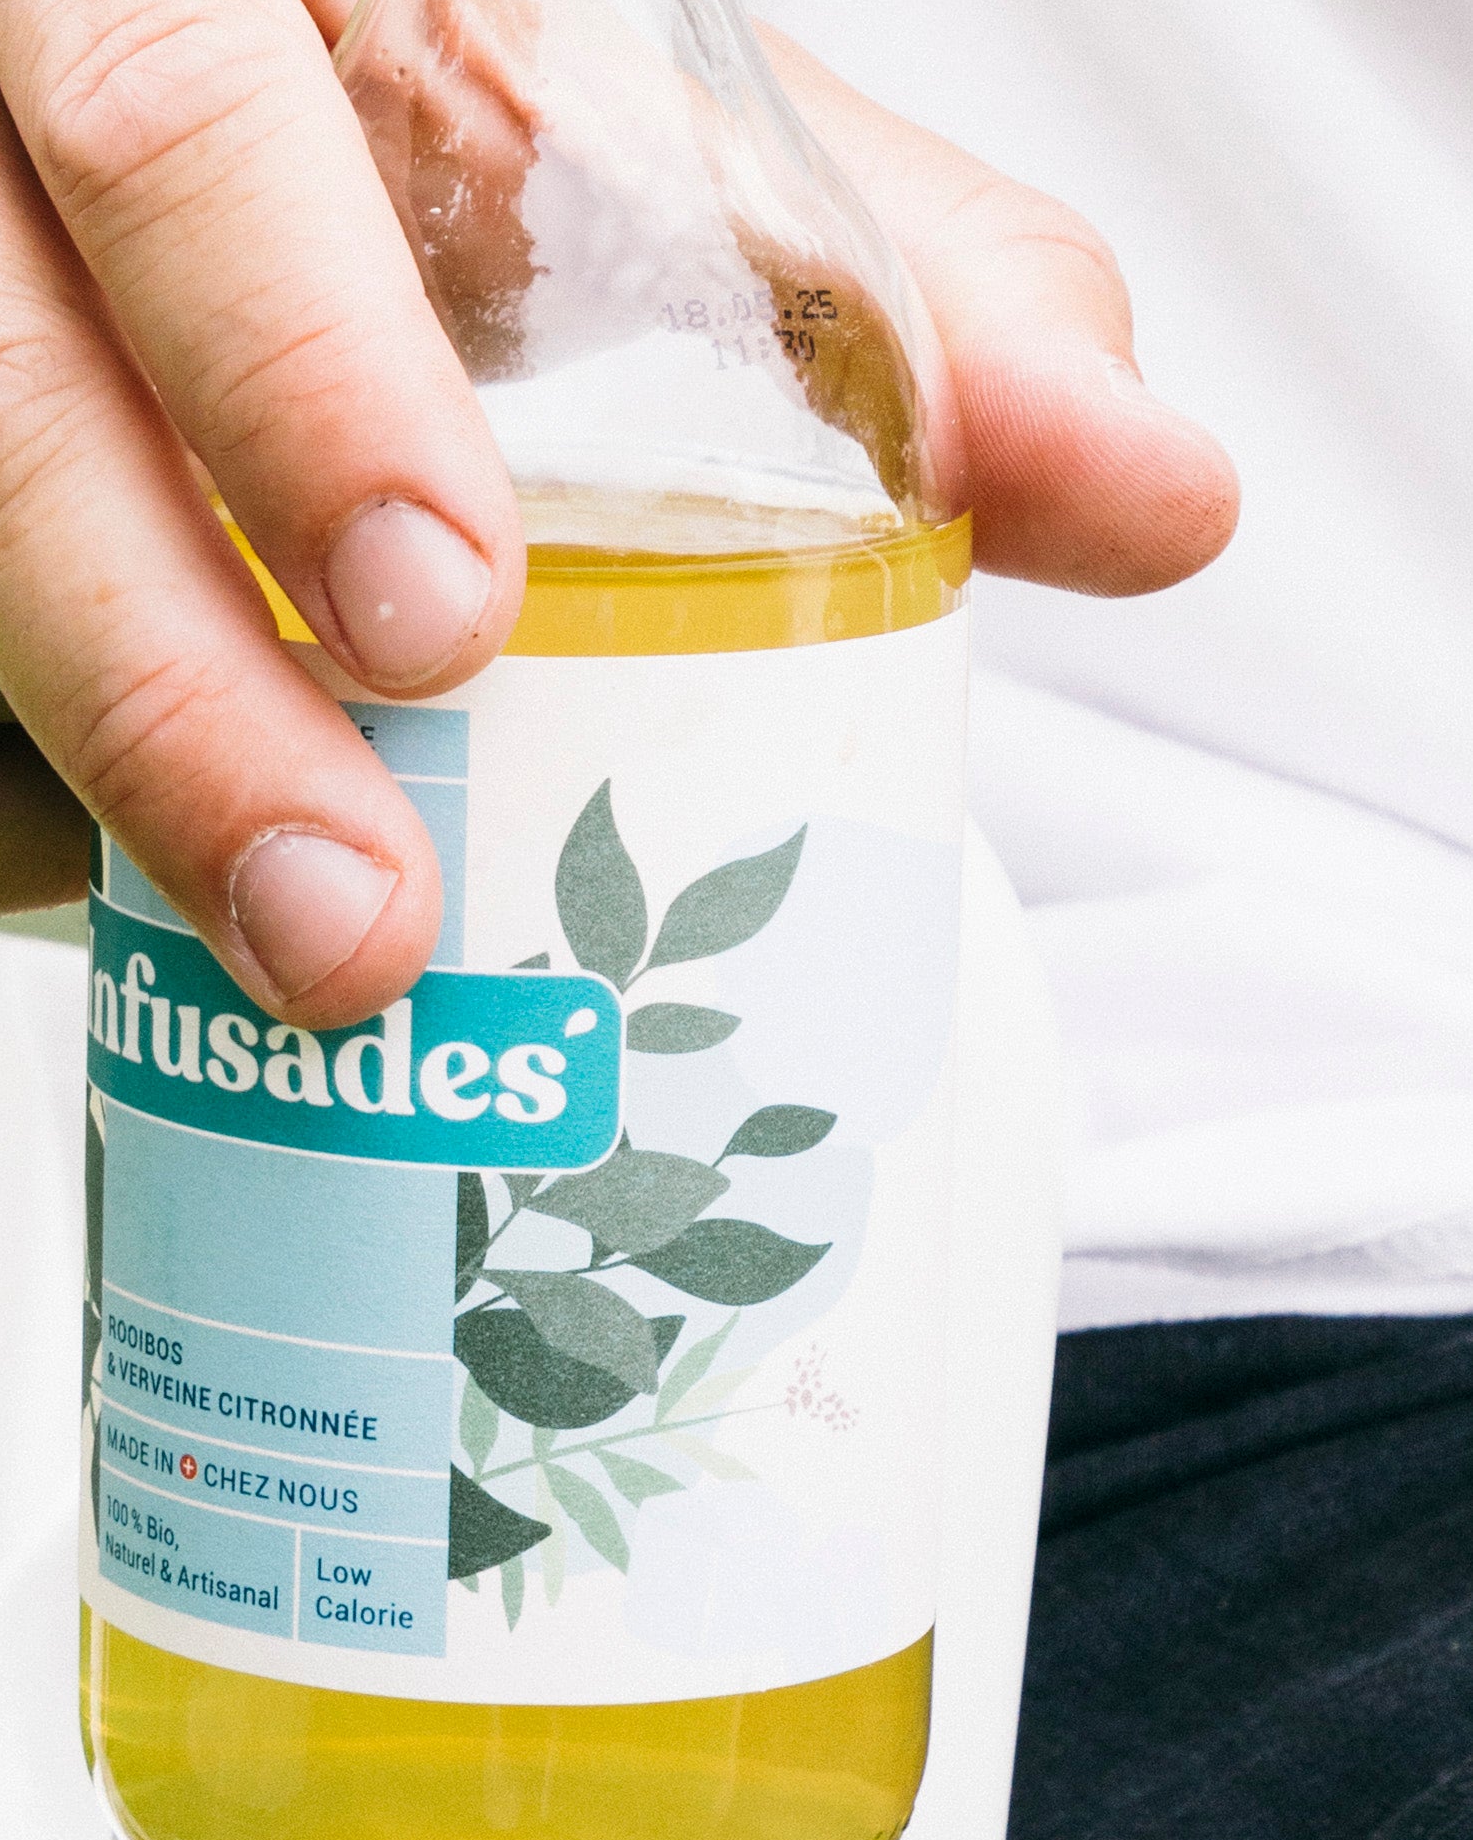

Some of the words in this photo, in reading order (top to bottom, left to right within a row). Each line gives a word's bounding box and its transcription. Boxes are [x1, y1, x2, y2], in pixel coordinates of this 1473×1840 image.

[108, 1314, 183, 1366] ROOIBOS
[107, 1351, 117, 1376] &
[119, 1356, 211, 1411] VERVEINE
[218, 1391, 378, 1441] CITRONNÉE
[107, 1424, 149, 1467] MADE
[154, 1447, 174, 1476] IN
[204, 1463, 269, 1499] CHEZ
[278, 1479, 359, 1514] NOUS
[107, 1494, 129, 1528] 100
[147, 1519, 180, 1551] Bio,
[105, 1532, 156, 1577] Naturel
[159, 1558, 172, 1583] &
[177, 1565, 280, 1611] Artisanal
[317, 1557, 372, 1587] Low
[315, 1594, 414, 1629] Calorie
